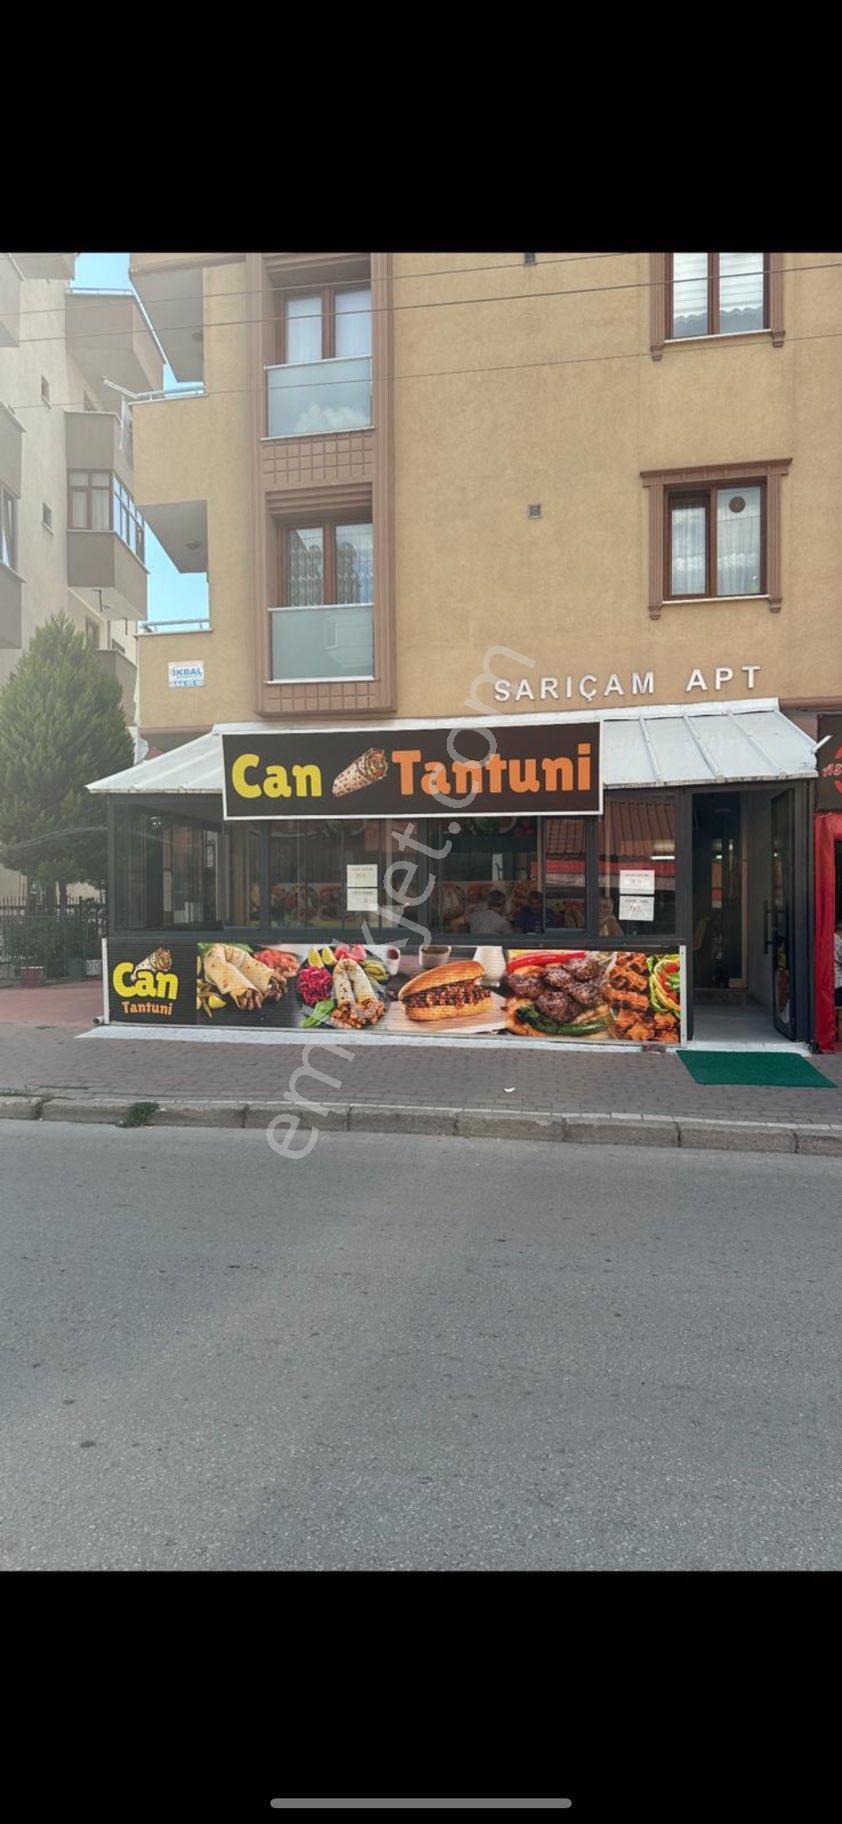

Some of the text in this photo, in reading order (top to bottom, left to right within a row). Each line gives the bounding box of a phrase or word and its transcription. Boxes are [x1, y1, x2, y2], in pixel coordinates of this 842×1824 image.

[494, 665, 761, 702] SARIÇAM APT
[231, 743, 593, 799] Can Tantuni
[112, 961, 179, 1000] Can
[121, 1001, 173, 1016] Tantuni
